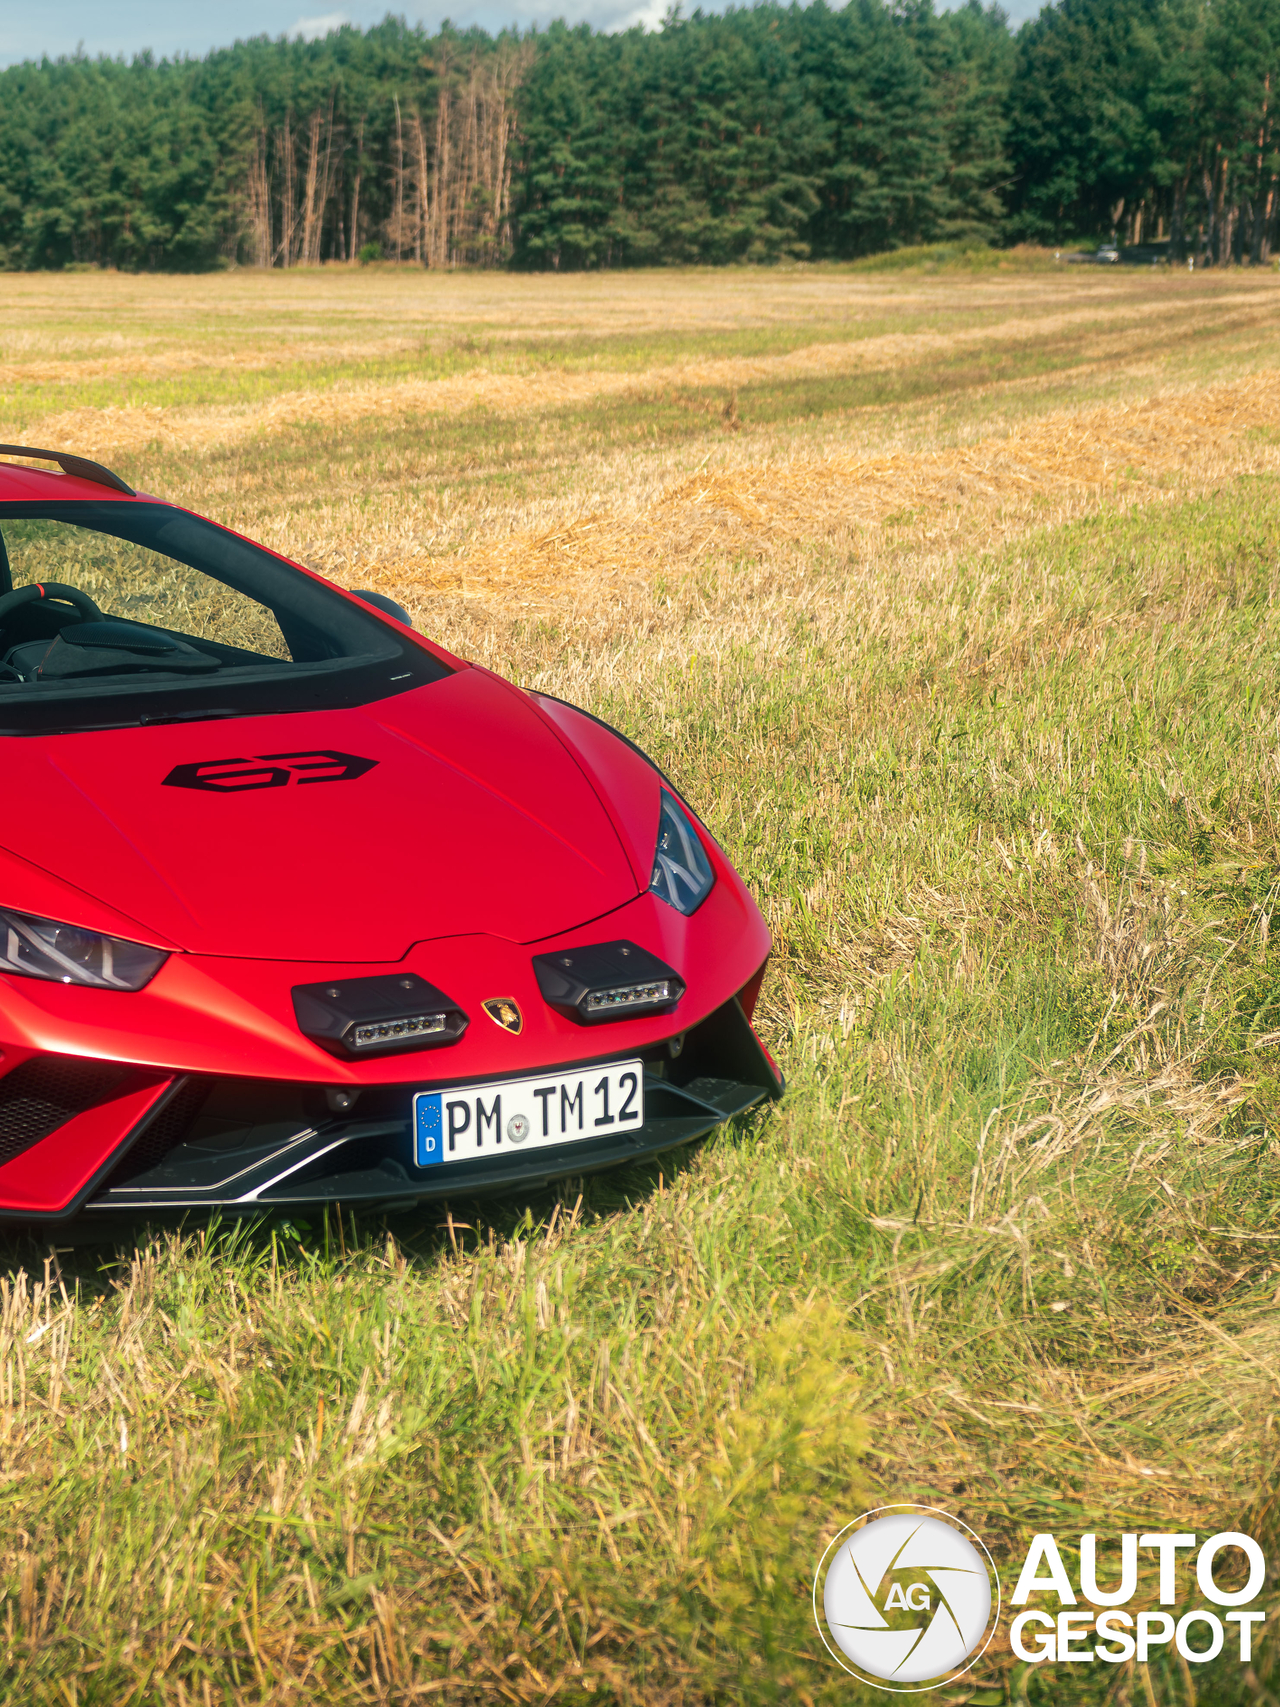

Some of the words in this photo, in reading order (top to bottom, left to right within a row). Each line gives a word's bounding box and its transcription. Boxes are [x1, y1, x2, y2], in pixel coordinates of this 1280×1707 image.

[161, 750, 380, 793] 63
[445, 1094, 502, 1152] PM
[533, 1081, 583, 1137] TM
[594, 1072, 639, 1127] 12
[425, 1136, 436, 1152] D
